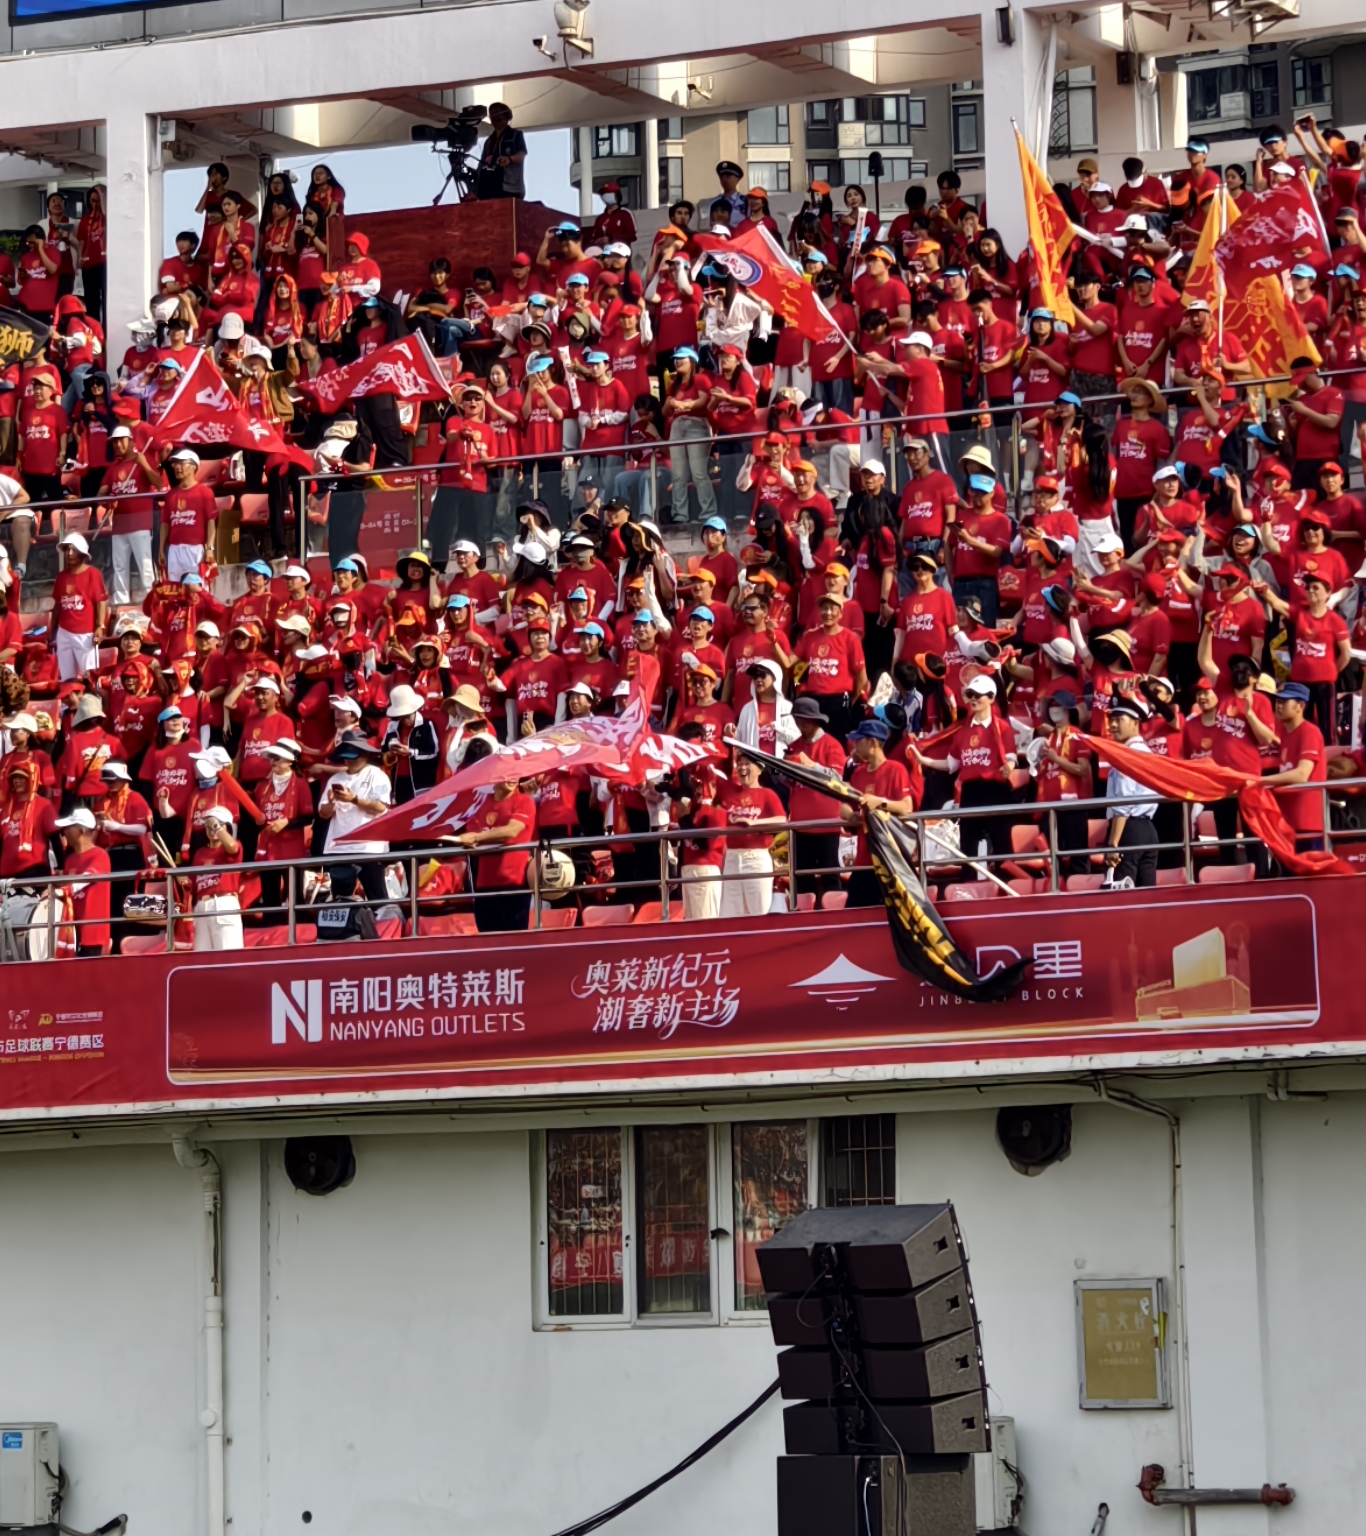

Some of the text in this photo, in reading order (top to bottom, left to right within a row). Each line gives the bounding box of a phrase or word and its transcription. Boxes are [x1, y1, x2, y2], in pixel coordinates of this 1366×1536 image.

[329, 968, 525, 1014] 南阳奥特莱斯
[571, 949, 731, 998] 奥莱新纪元
[1021, 987, 1084, 1001] BLOCK
[330, 1012, 526, 1041] NANYANG OUTLETS
[592, 987, 741, 1040] 潮奢新主场
